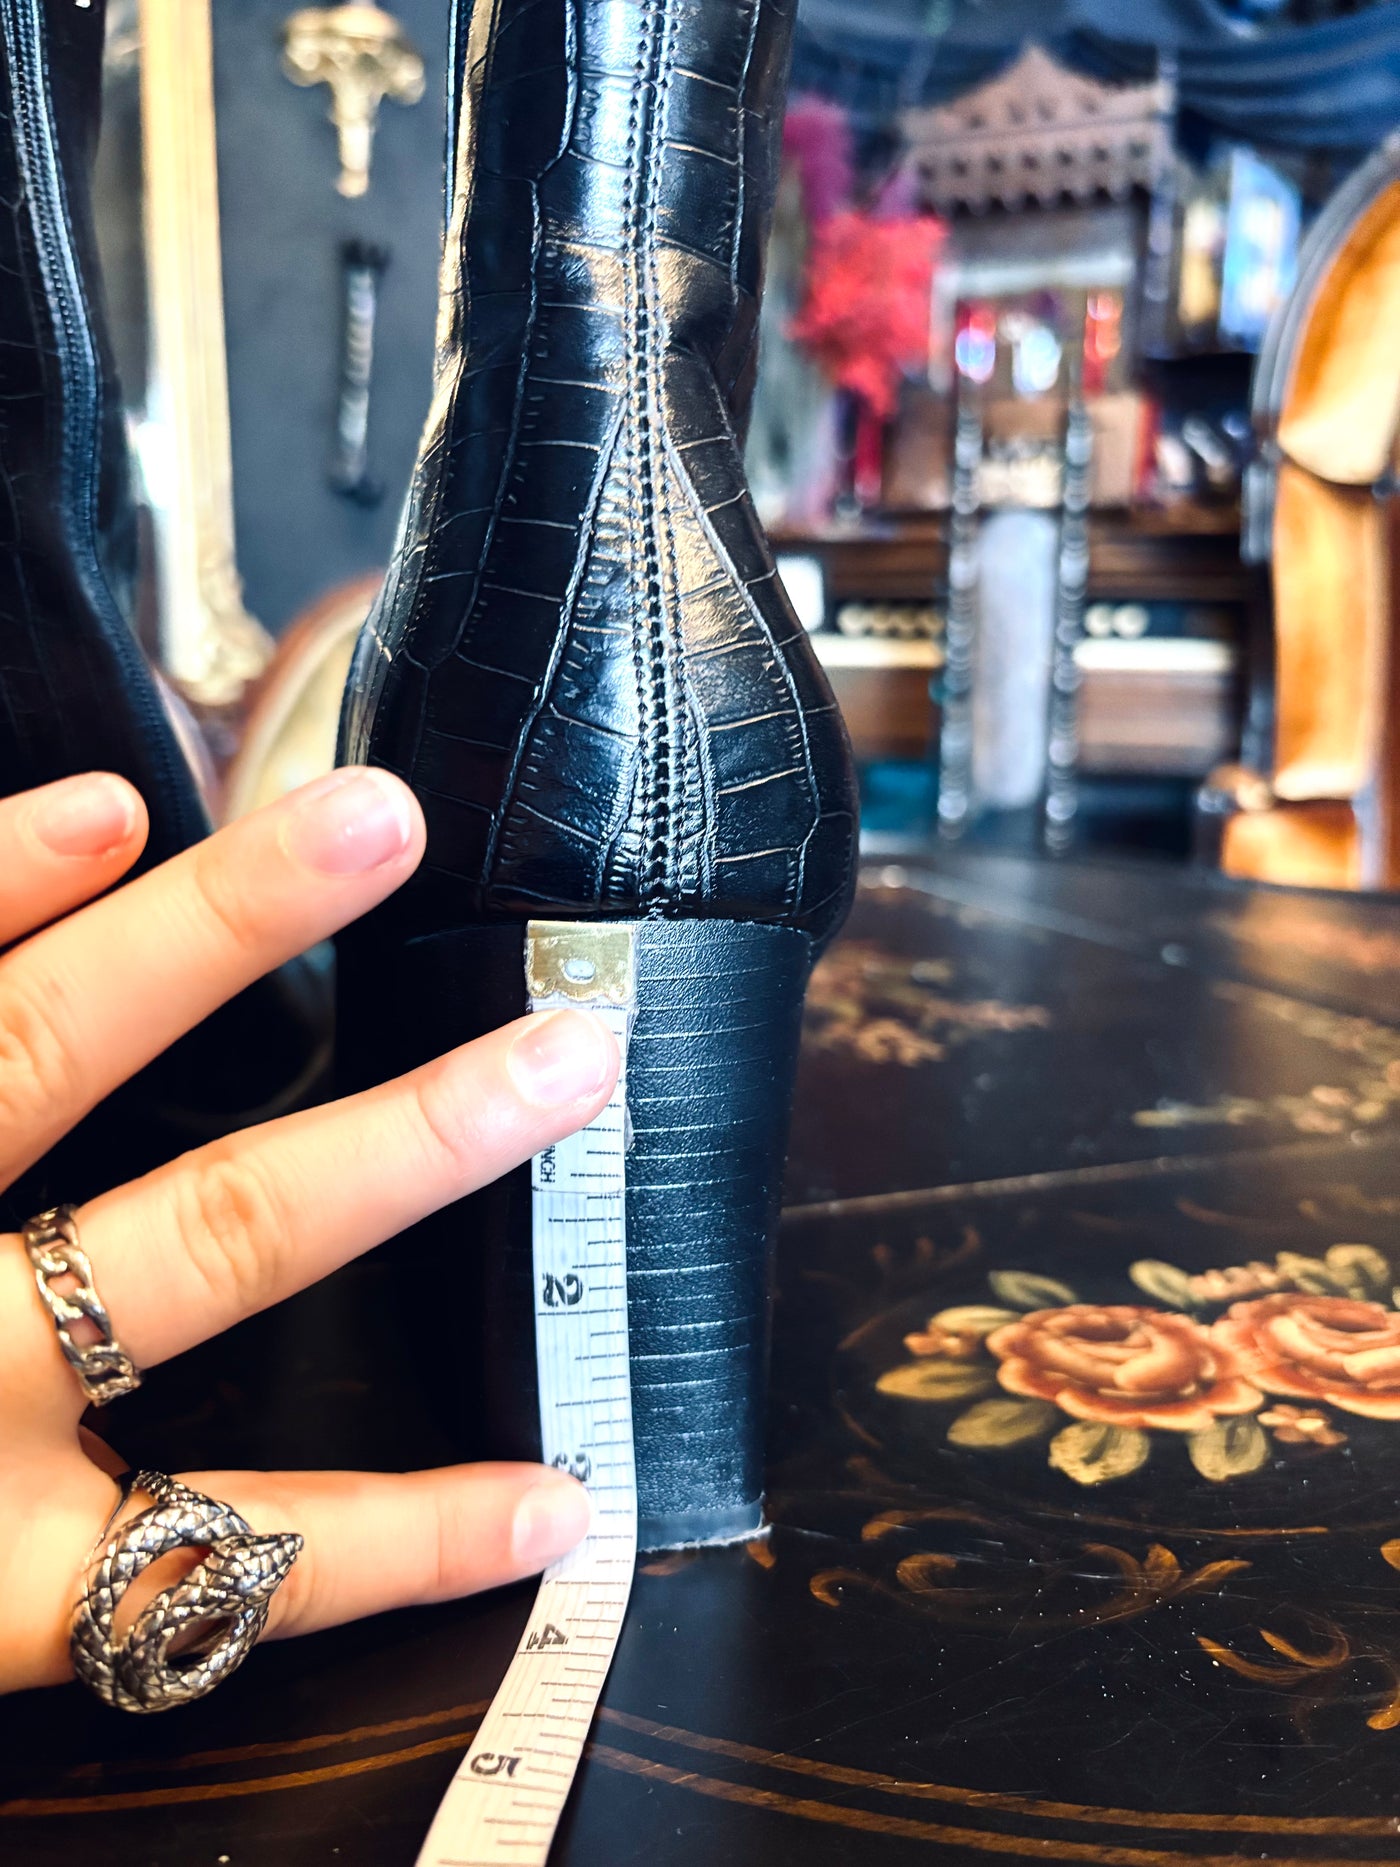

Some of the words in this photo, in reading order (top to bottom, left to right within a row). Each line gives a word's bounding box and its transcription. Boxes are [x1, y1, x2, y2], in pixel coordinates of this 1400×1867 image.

[540, 1145, 556, 1183] NCH
[542, 1272, 584, 1308] 2
[525, 1623, 570, 1650] 4
[470, 1752, 522, 1777] 5
